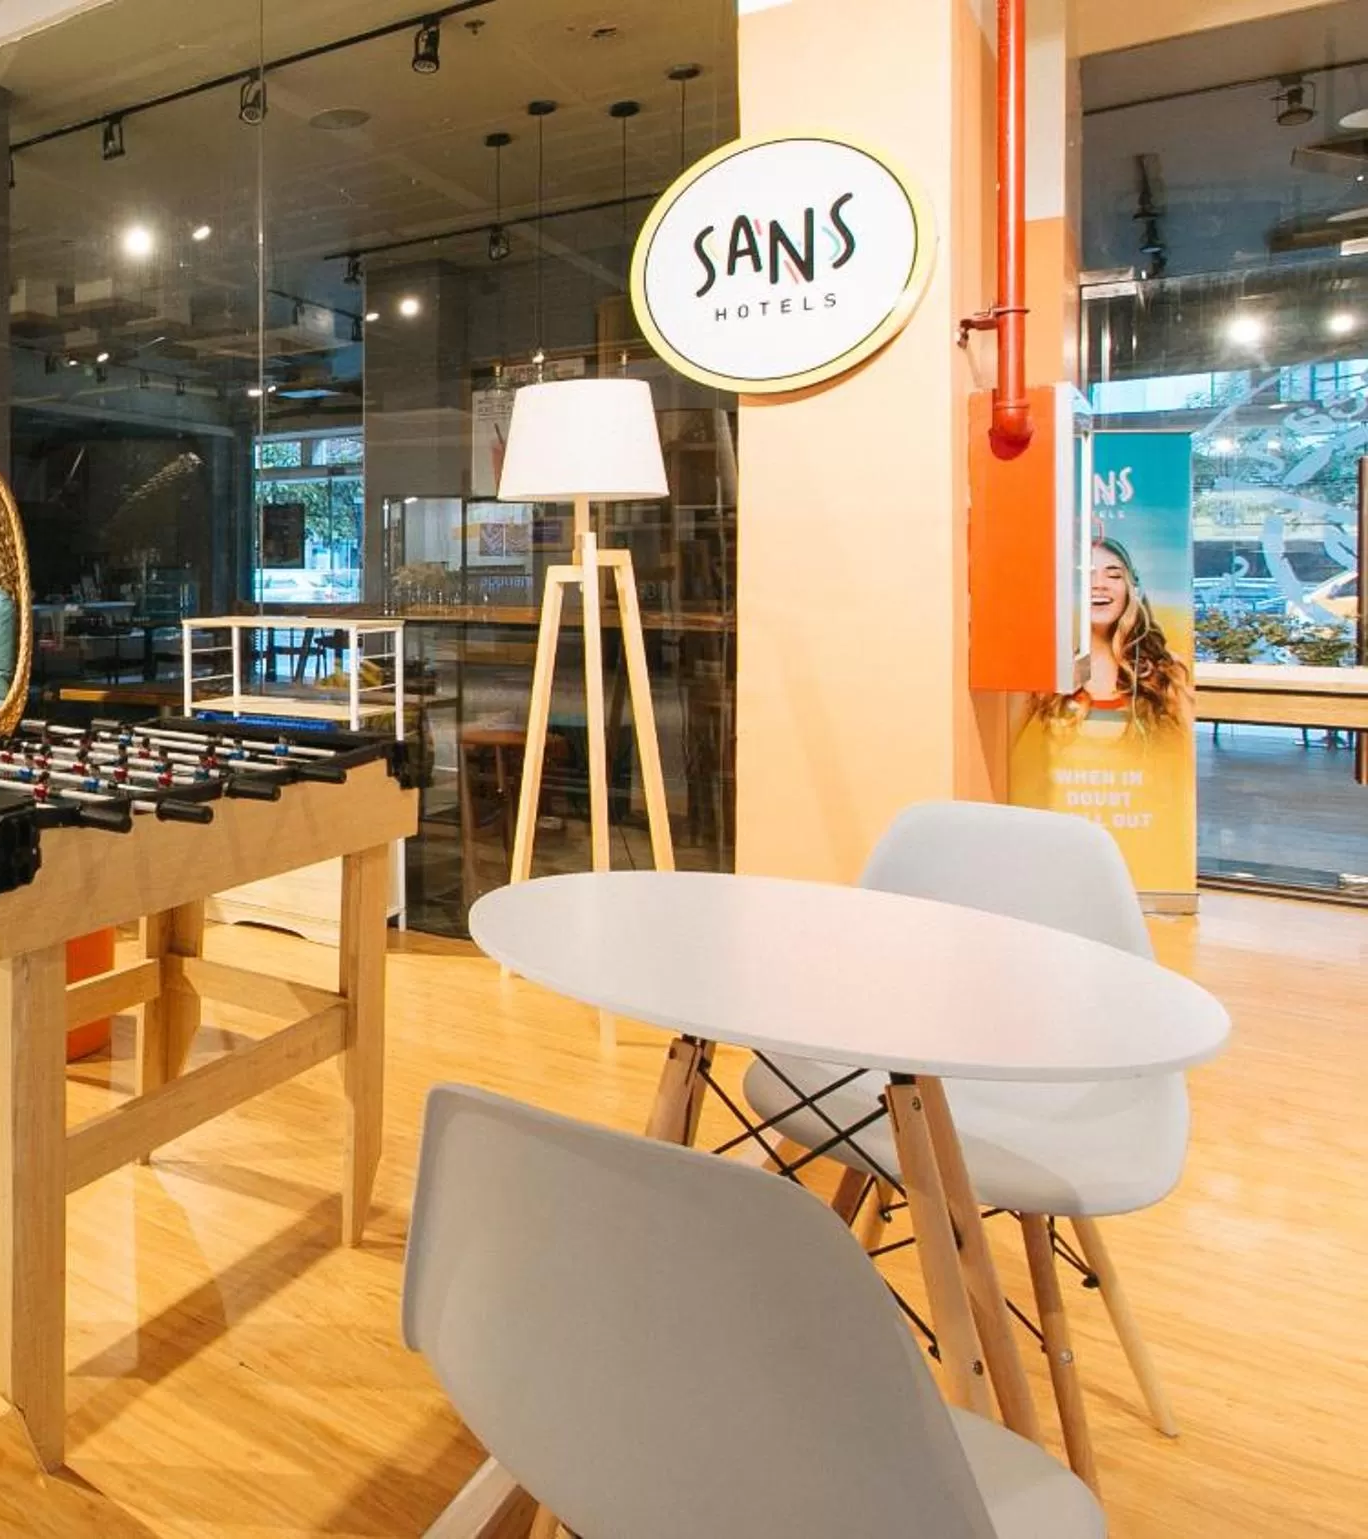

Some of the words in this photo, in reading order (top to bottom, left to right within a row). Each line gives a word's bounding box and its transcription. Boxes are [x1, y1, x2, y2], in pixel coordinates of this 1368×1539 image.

[693, 191, 856, 298] SANS
[714, 293, 838, 322] HOTELS
[1093, 465, 1134, 506] NS
[1053, 769, 1114, 785] WHEN
[1122, 769, 1145, 786] IN
[1066, 791, 1131, 808] DOUBT
[1112, 812, 1153, 828] OUT
